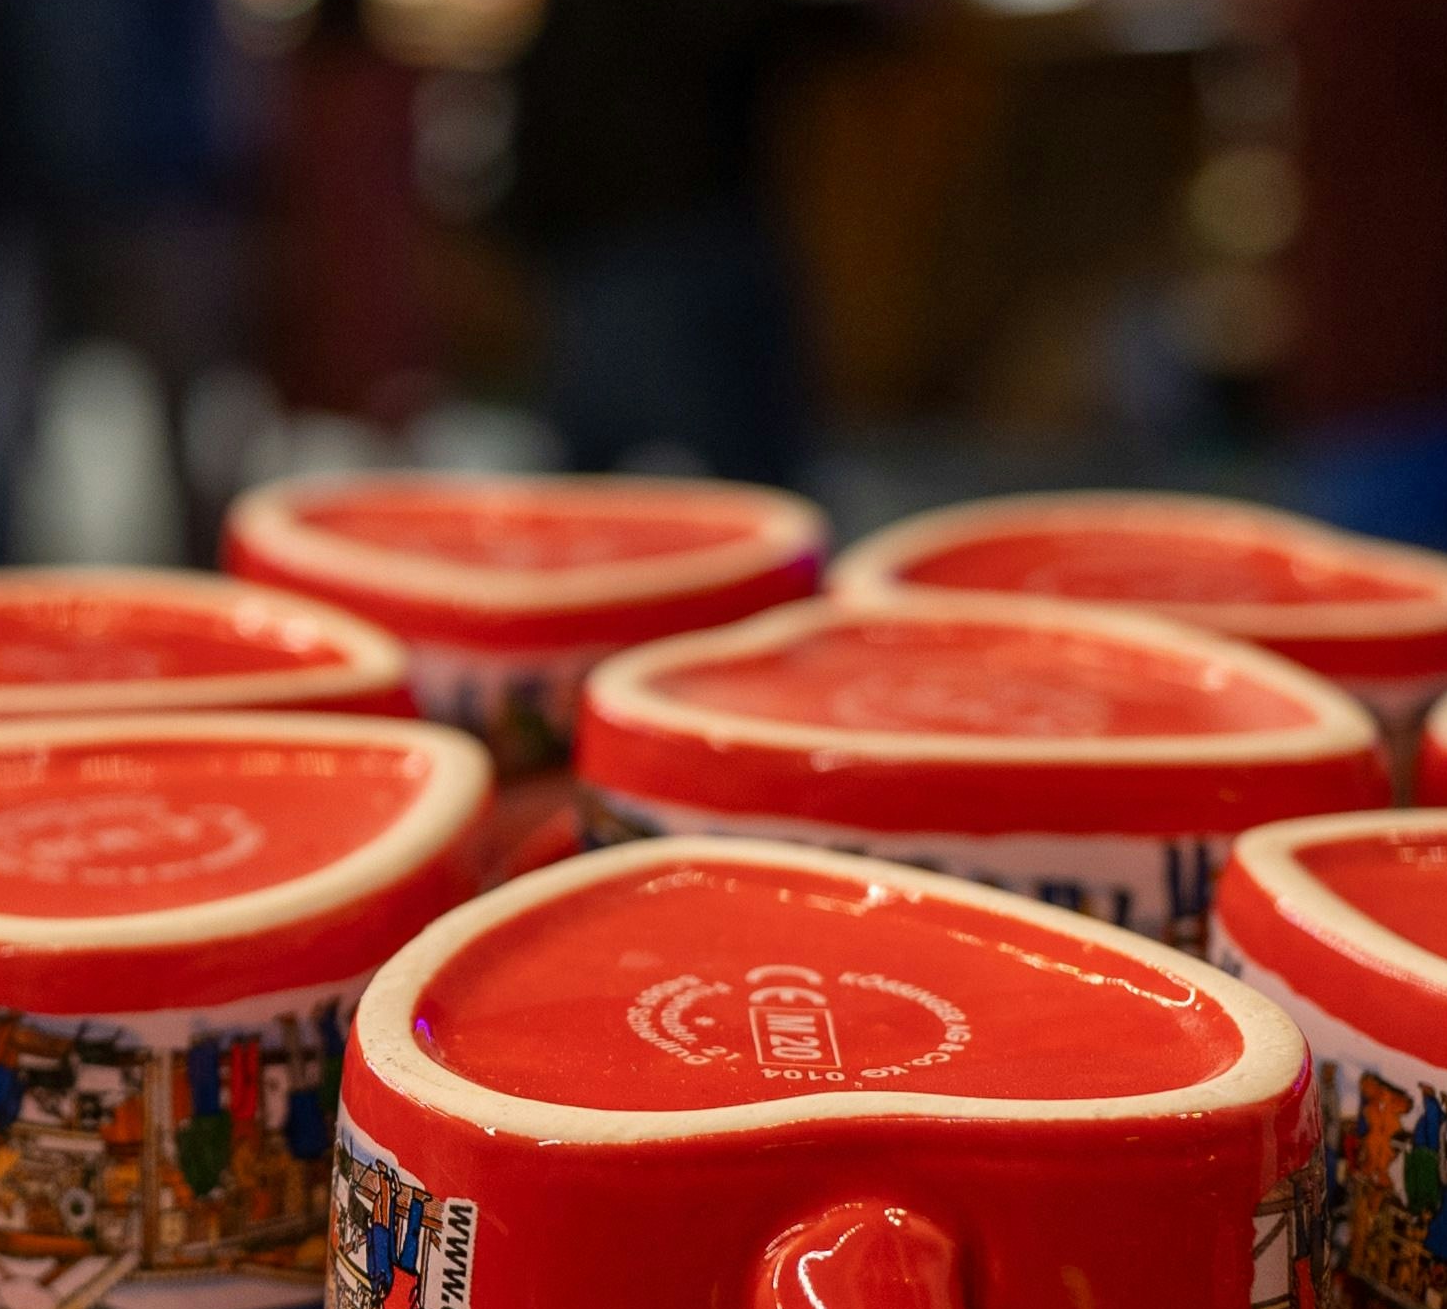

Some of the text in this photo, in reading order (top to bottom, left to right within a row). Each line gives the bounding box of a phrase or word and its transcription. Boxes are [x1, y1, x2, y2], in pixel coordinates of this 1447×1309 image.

[766, 1013, 822, 1059] M 20
[760, 1067, 845, 1081] 0104
[860, 1065, 909, 1078] KG
